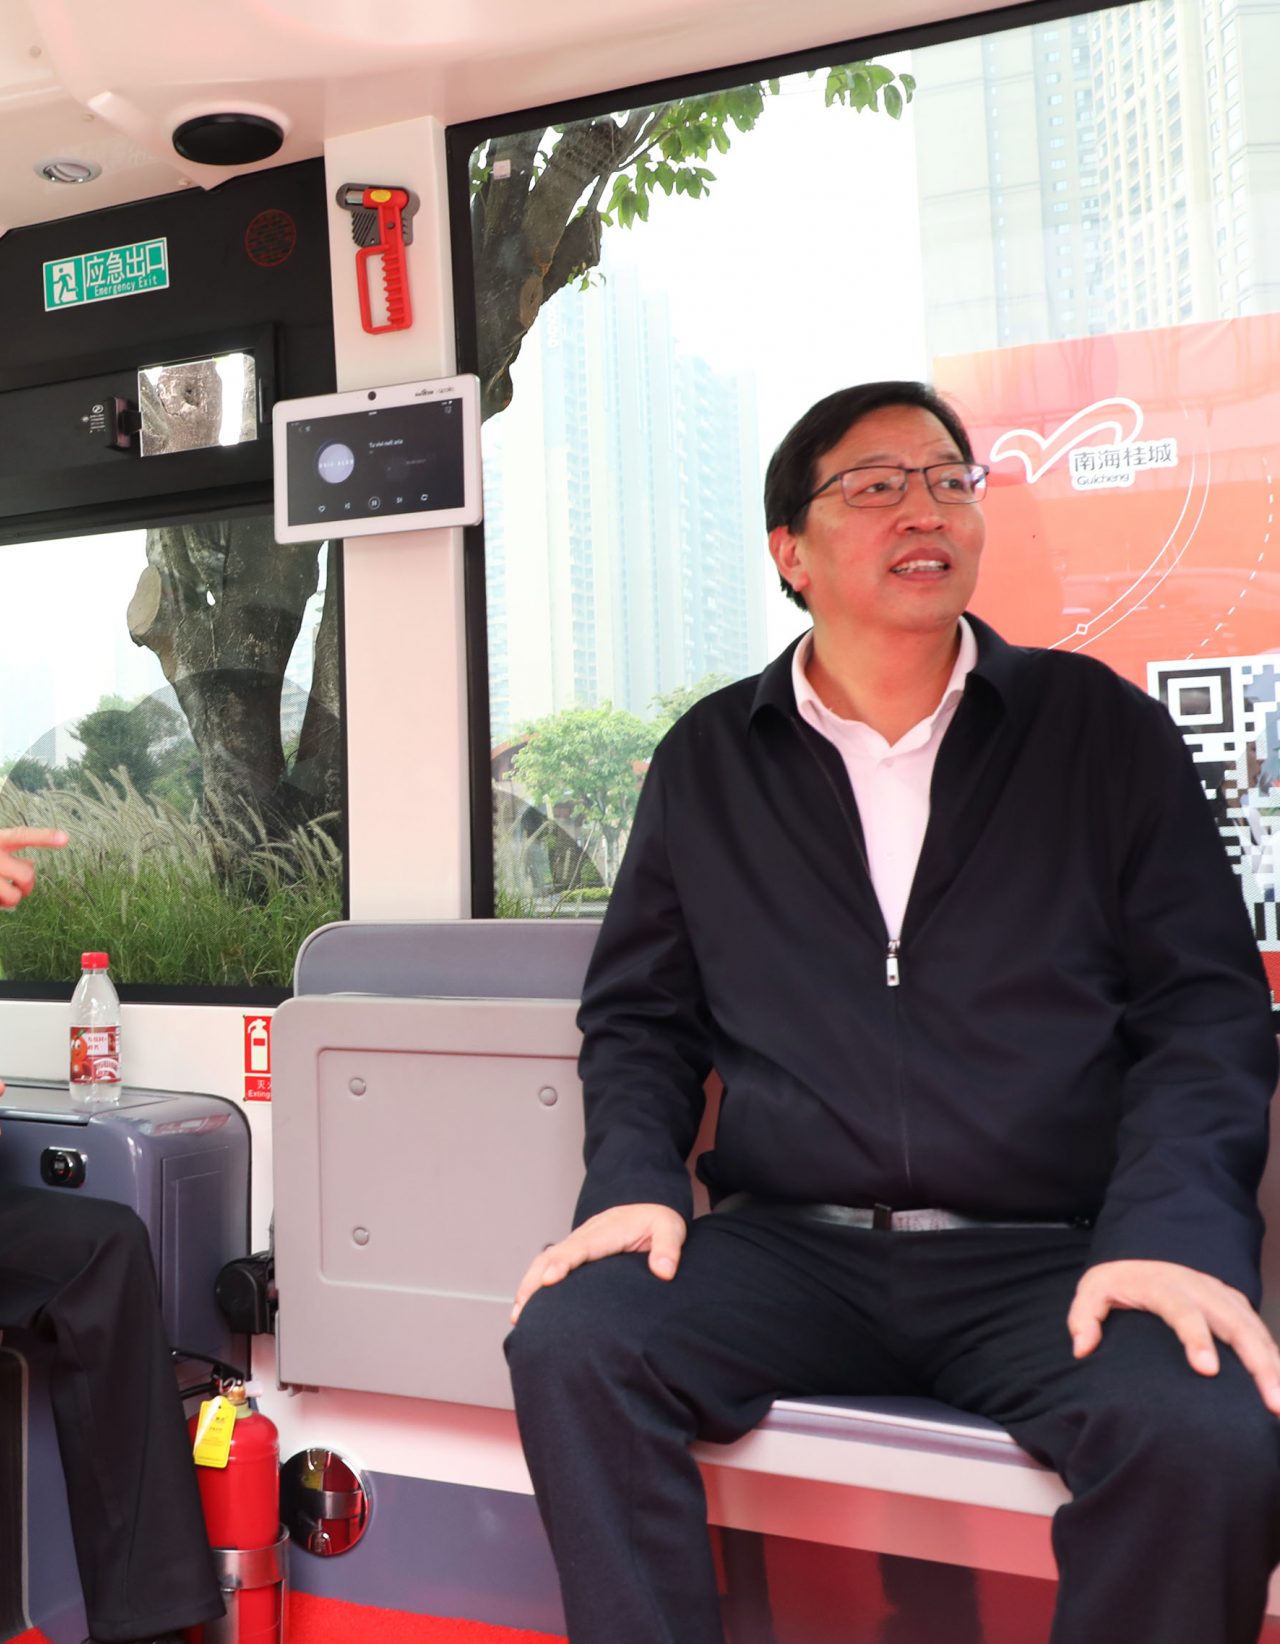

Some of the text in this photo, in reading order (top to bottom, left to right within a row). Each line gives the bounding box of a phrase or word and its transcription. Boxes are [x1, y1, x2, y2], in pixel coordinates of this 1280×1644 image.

[86, 242, 165, 287] 应急出口
[94, 274, 158, 297] Emergency Exit
[1073, 443, 1172, 472] 南海桂城
[1076, 473, 1130, 486] Guicheng
